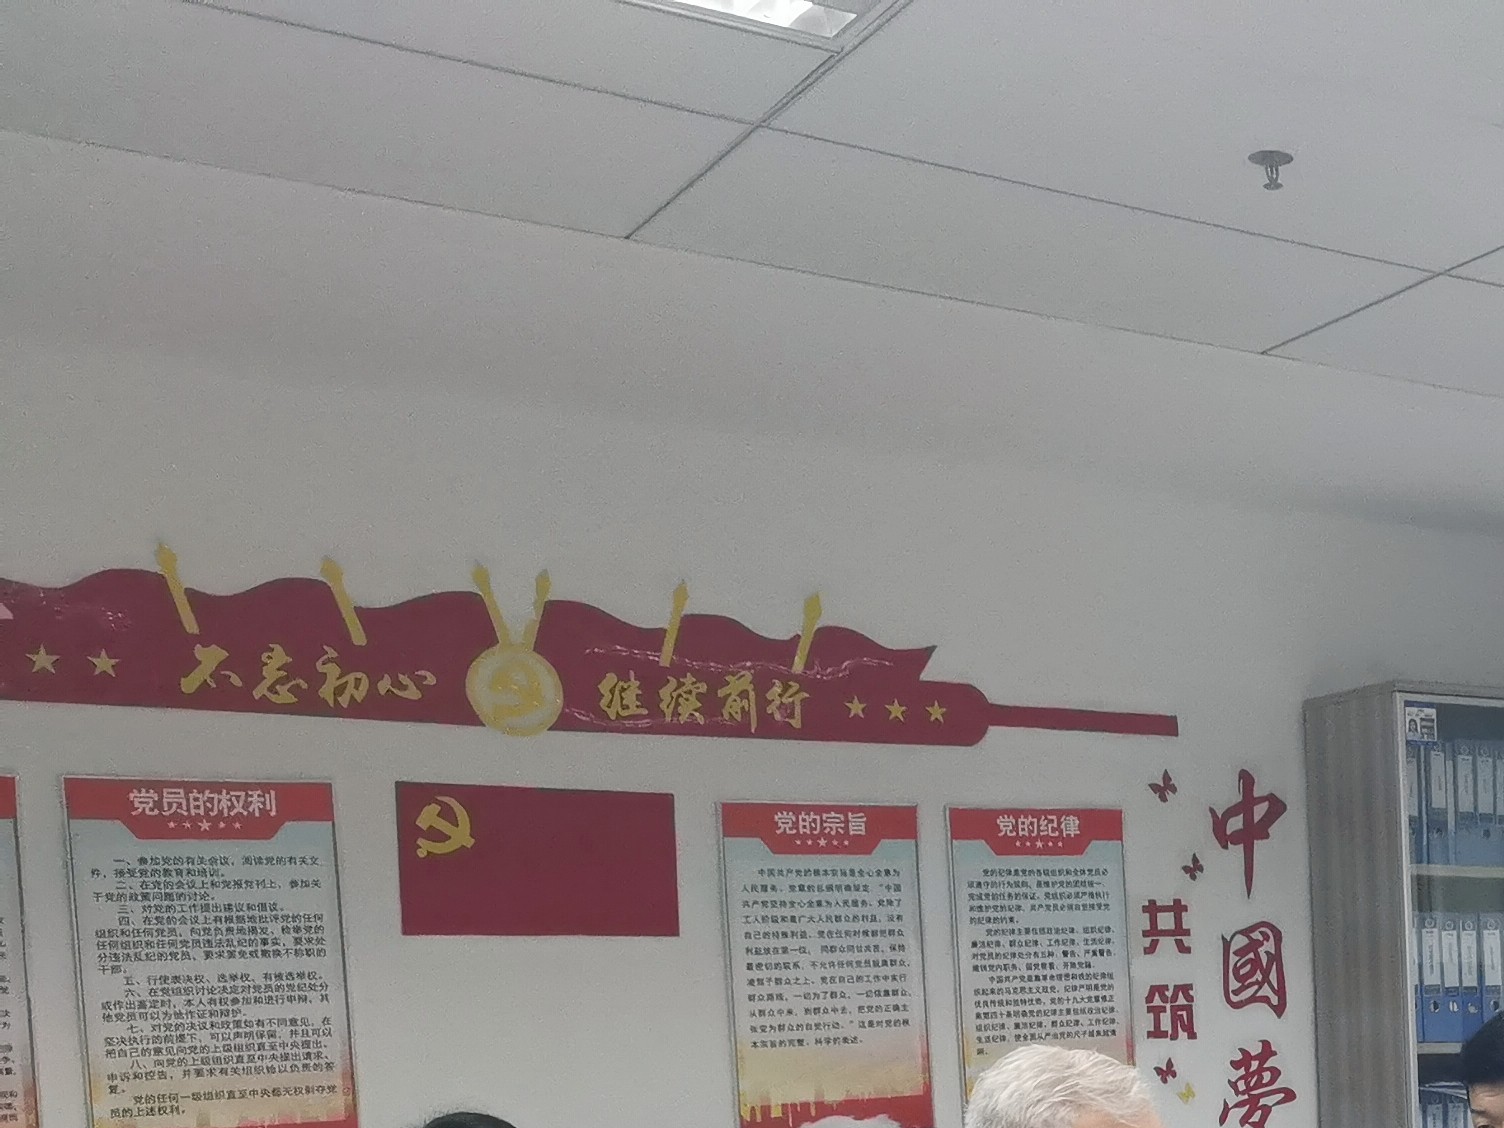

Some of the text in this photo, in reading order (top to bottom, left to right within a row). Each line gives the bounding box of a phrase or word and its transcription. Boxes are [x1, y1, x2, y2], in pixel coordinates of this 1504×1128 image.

[180, 643, 810, 734] 不忘初心 继续前行
[127, 788, 277, 817] 党员的权利
[774, 811, 867, 836] 党的宗旨
[996, 814, 1081, 838] 党的纪律
[1141, 898, 1197, 1040] 共筑
